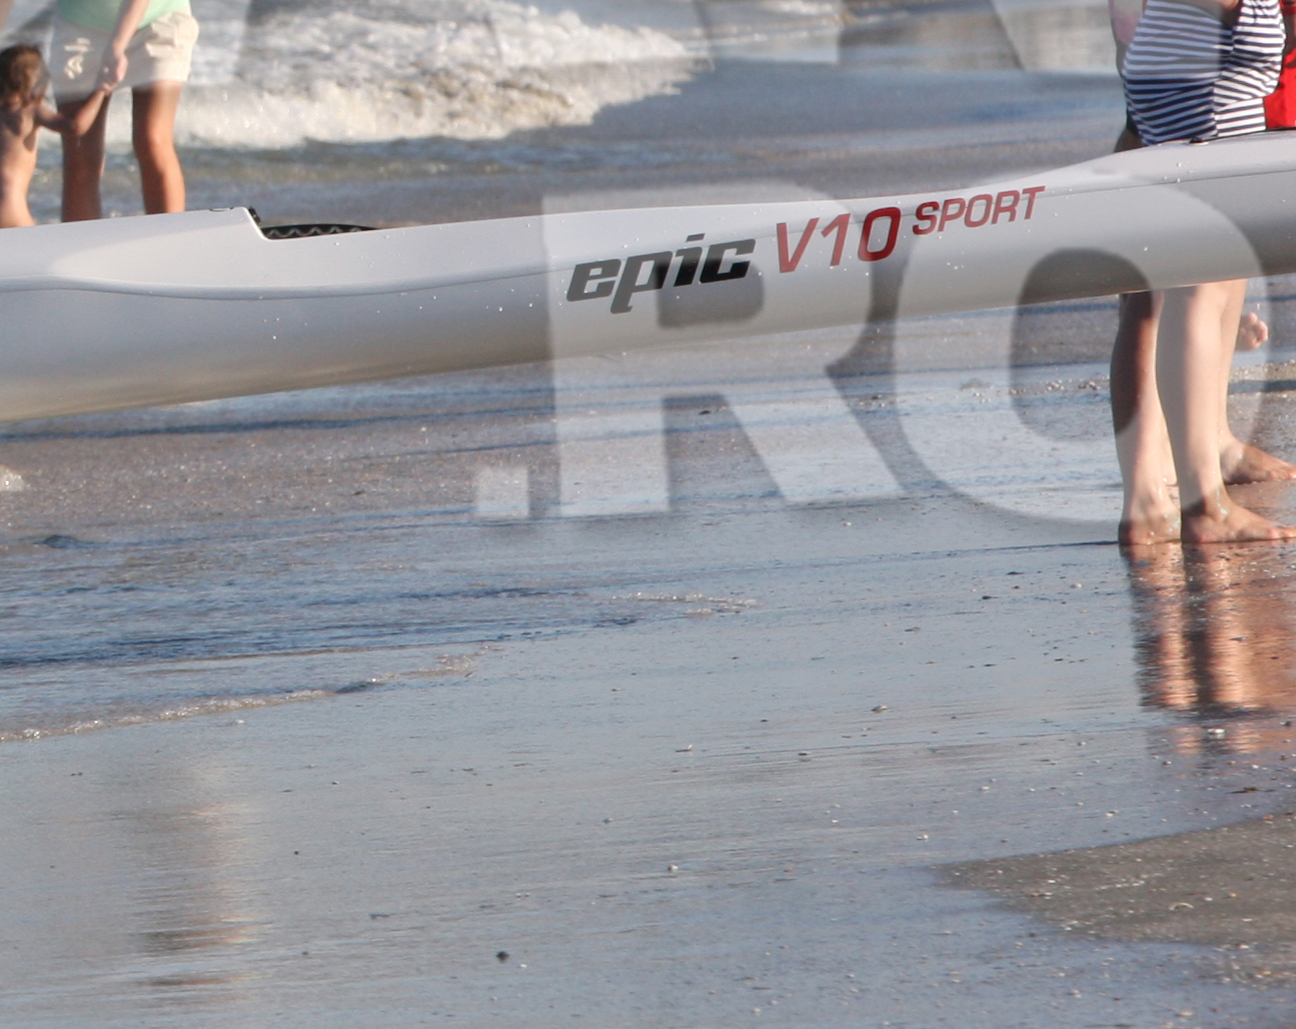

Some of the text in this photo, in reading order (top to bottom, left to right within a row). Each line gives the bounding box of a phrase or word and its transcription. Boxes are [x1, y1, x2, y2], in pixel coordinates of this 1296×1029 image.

[566, 185, 1045, 314] epic V10 SPORT
